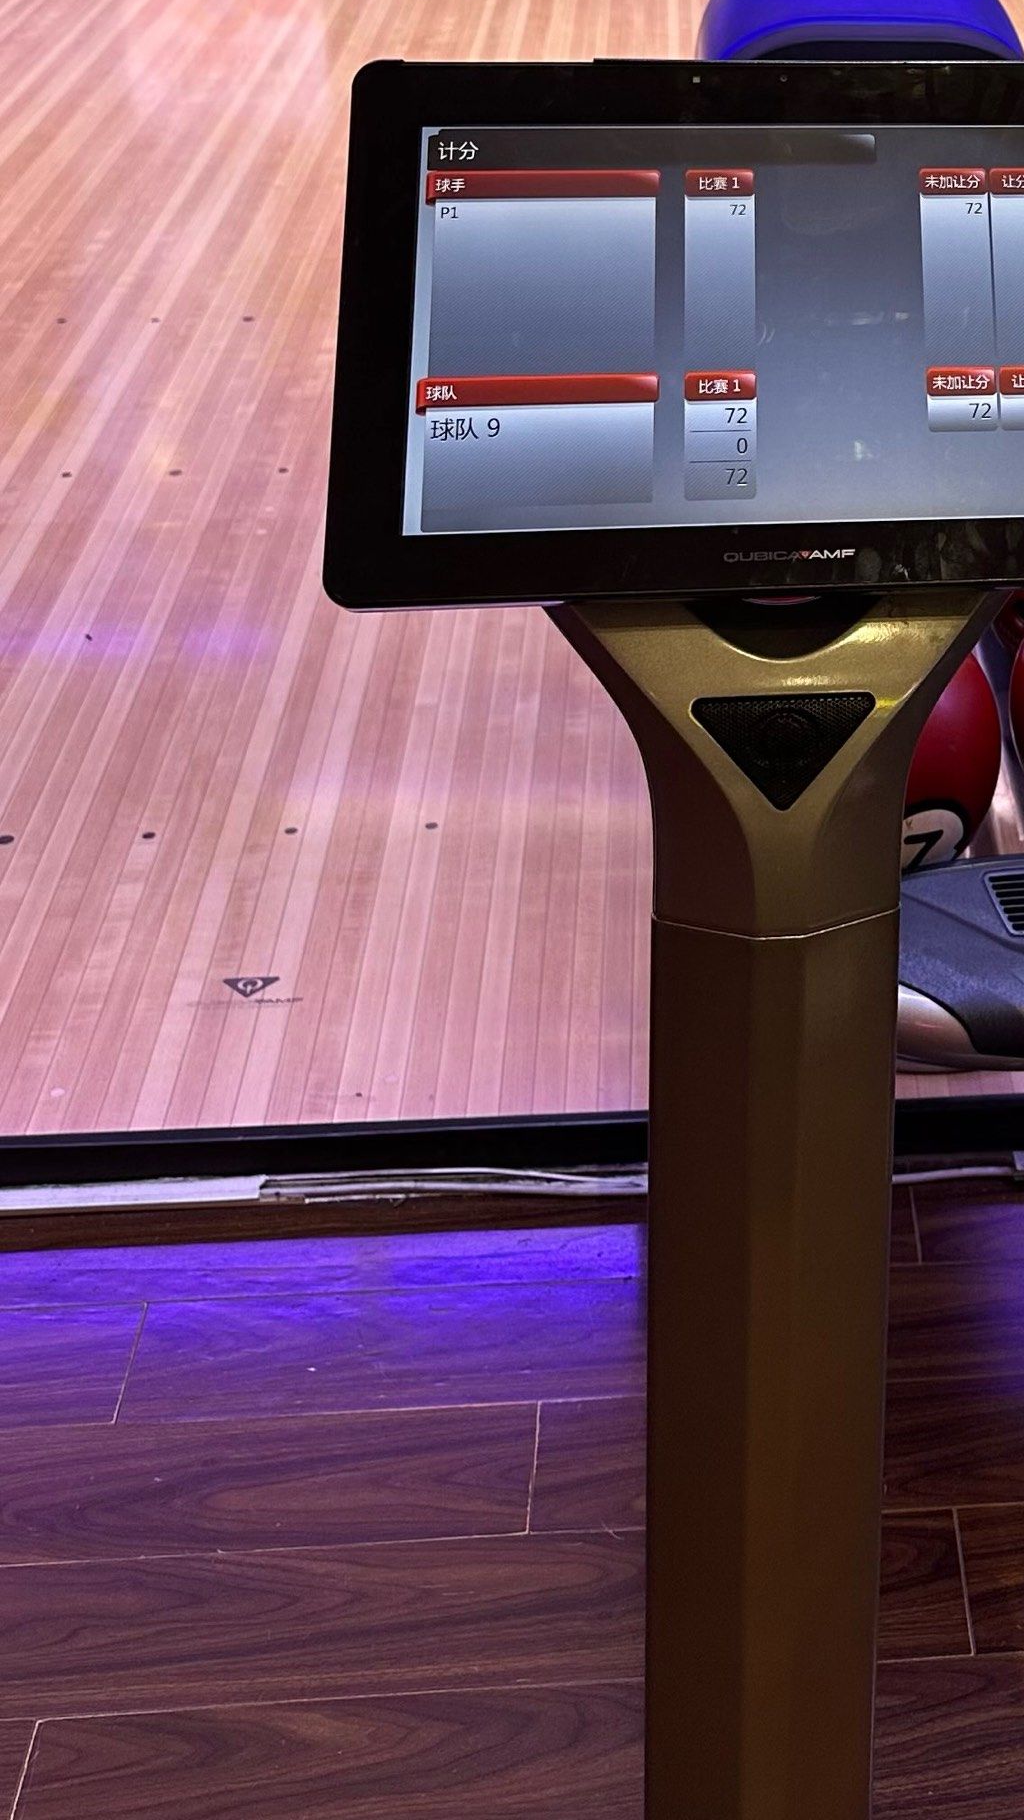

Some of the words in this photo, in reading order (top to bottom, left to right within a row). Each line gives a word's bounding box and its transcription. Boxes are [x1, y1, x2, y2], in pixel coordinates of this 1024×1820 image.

[438, 141, 479, 161] 计分
[435, 178, 465, 192] 球手
[698, 176, 728, 191] 比赛
[732, 177, 740, 189] 1
[925, 174, 981, 189] 未加让分
[440, 207, 459, 219] P1
[730, 204, 746, 216] 72
[965, 202, 983, 215] 72
[699, 379, 728, 394] 比赛
[732, 380, 741, 393] 1
[933, 374, 990, 390] 未加让分
[426, 386, 457, 400] 球队
[725, 408, 747, 424] 72
[969, 403, 992, 419] 72
[430, 418, 479, 441] 球队
[487, 419, 500, 438] 9
[737, 438, 747, 454] 0
[725, 468, 747, 485] 72
